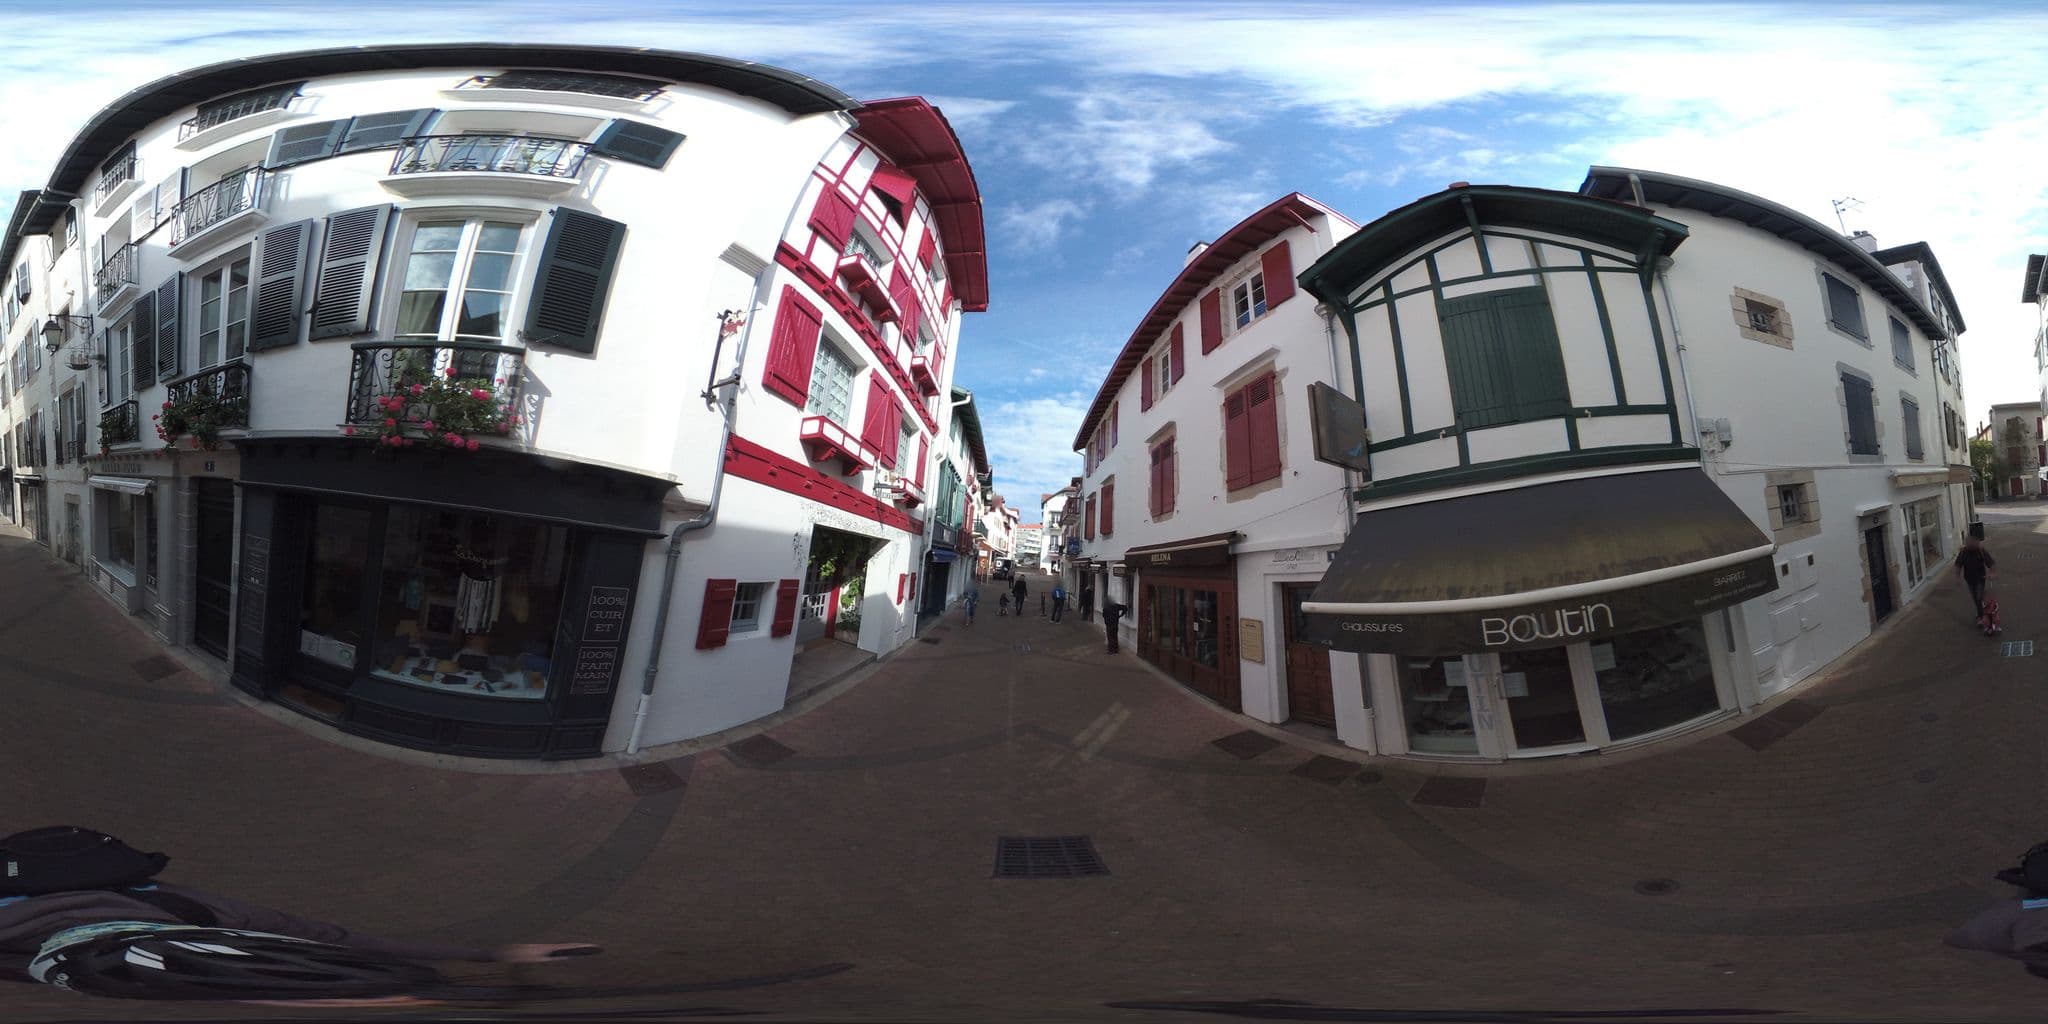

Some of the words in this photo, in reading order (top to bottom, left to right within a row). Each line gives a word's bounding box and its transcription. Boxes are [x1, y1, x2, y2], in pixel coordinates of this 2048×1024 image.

[591, 596, 625, 606] 100%
[589, 610, 623, 619] CUIR
[594, 623, 614, 632] ET
[1481, 603, 1614, 646] Boutin
[582, 651, 614, 659] 100%
[580, 662, 612, 670] FAIT
[575, 671, 612, 680] MAIN
